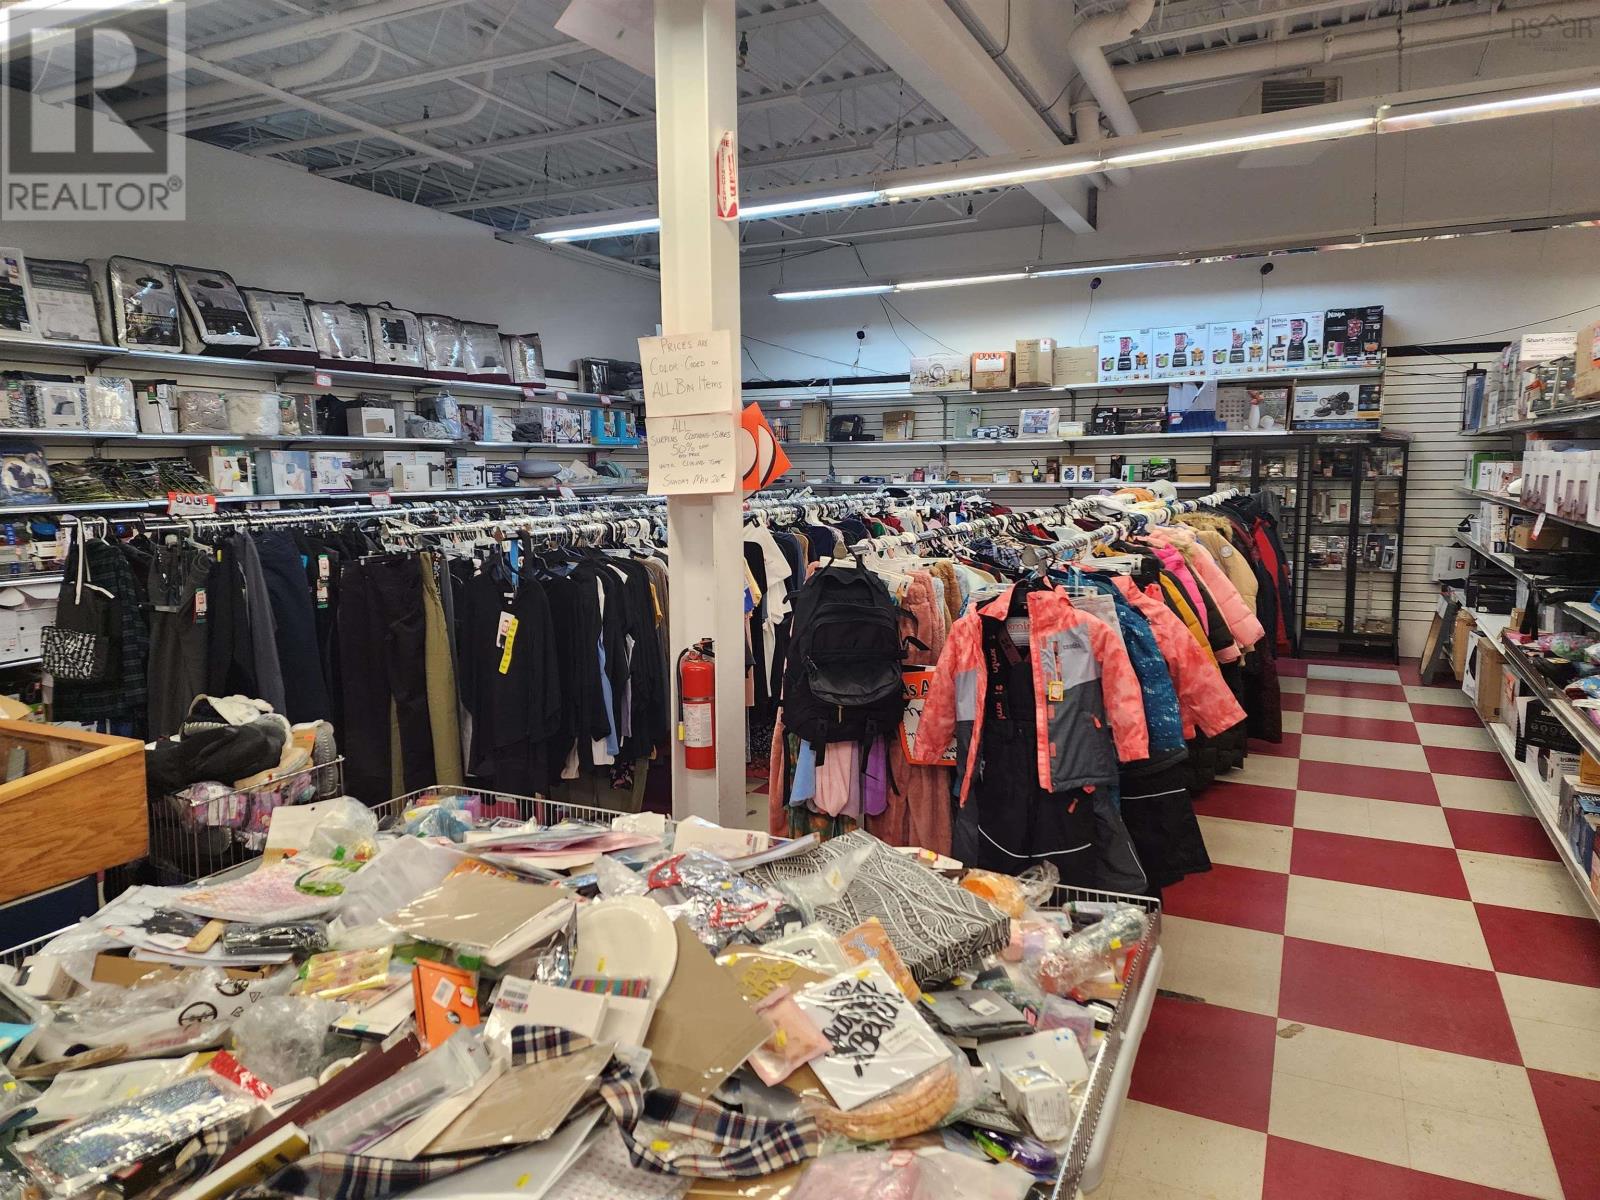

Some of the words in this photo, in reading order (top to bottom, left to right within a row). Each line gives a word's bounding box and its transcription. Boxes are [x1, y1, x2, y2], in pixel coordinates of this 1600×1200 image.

[660, 338, 693, 354] PRICES
[652, 381, 673, 398] ALL
[671, 418, 693, 433] ALL
[176, 495, 209, 506] SALE
